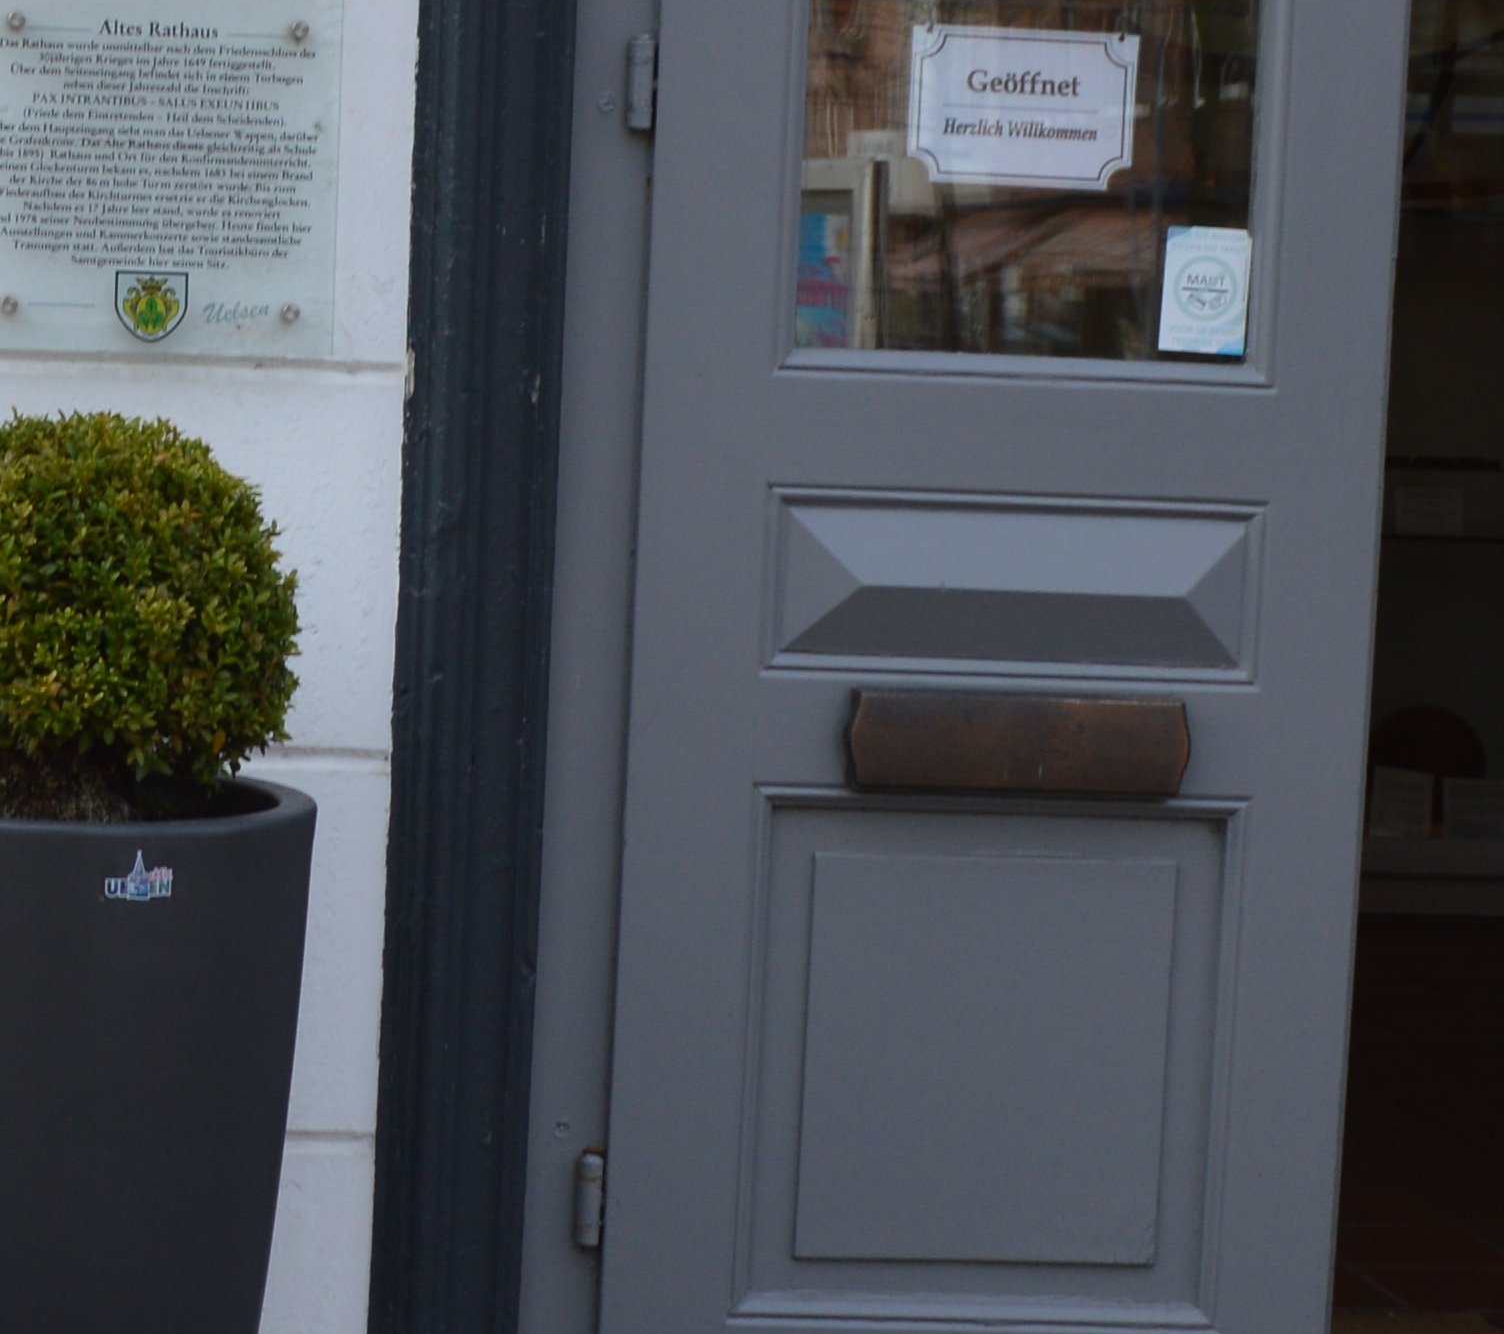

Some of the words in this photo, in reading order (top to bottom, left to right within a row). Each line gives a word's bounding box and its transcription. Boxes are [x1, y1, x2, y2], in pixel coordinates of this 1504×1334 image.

[99, 18, 142, 36] Altes
[148, 20, 218, 39] Rathaus
[966, 68, 1081, 98] Geöffnet
[943, 117, 1004, 138] Herzlich
[1008, 120, 1098, 142] Willkommen
[1186, 273, 1226, 286] MAUT
[202, 302, 271, 325] Uelsen
